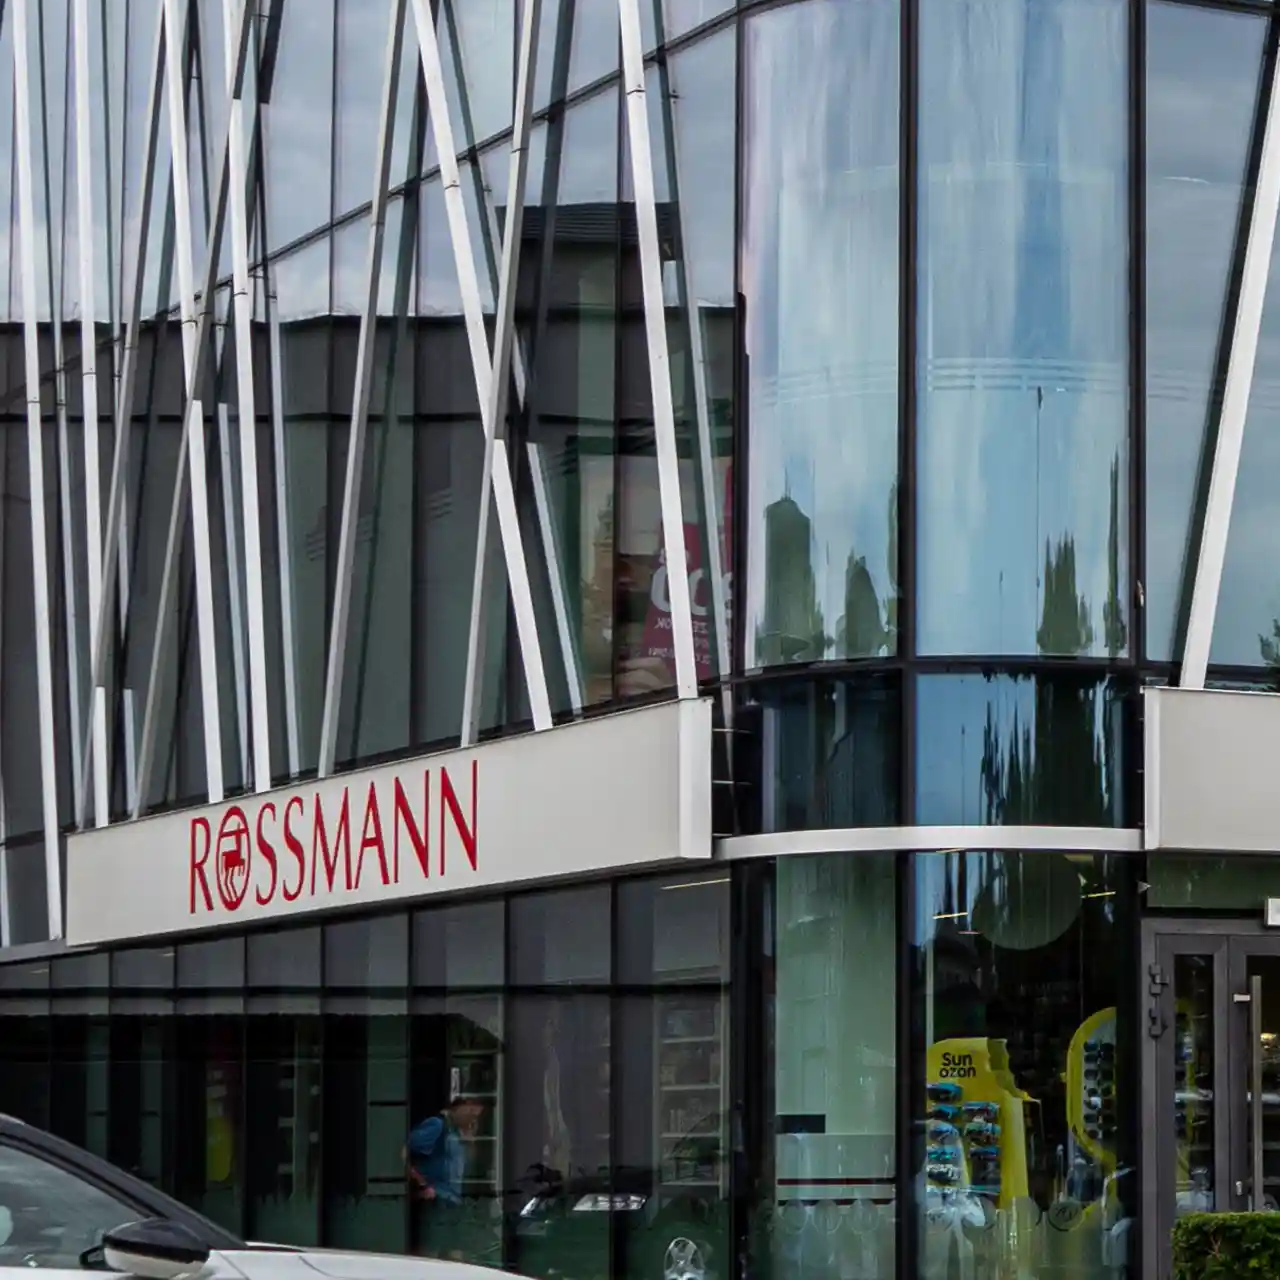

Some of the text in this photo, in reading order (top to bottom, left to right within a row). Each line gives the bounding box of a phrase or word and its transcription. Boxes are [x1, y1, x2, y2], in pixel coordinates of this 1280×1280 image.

[190, 759, 478, 914] ROSSMANN
[943, 1052, 973, 1066] Sun
[939, 1066, 976, 1078] ozon
